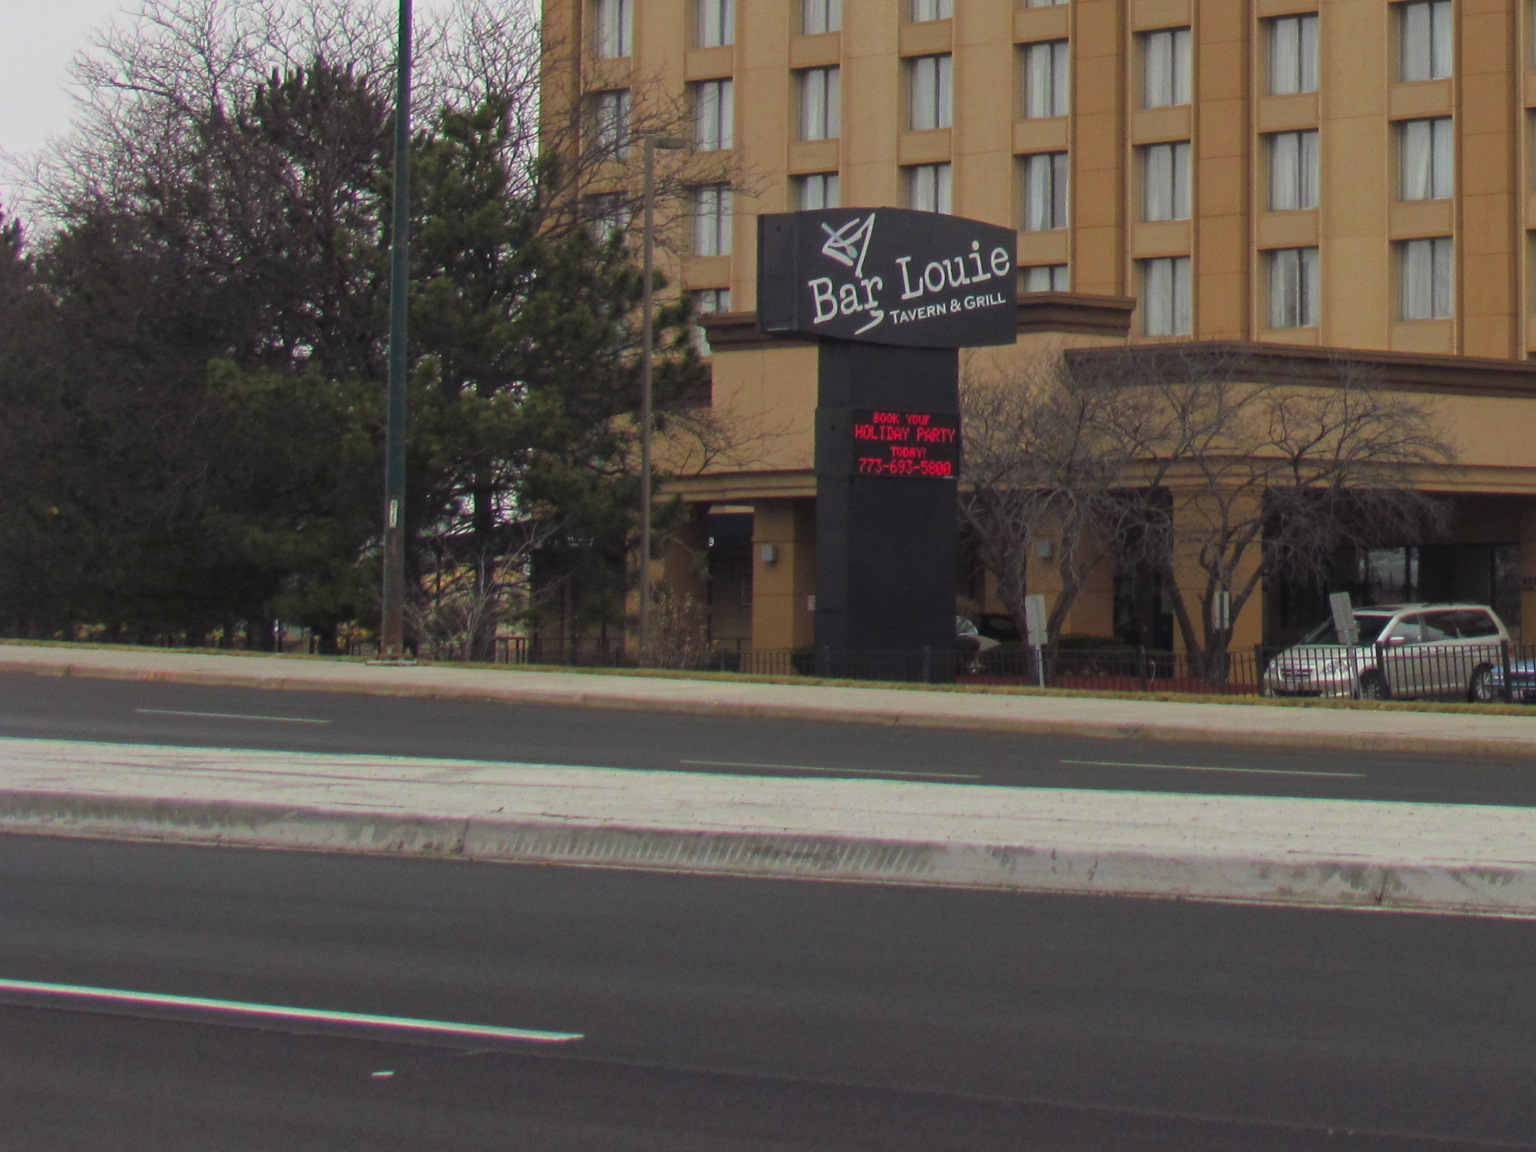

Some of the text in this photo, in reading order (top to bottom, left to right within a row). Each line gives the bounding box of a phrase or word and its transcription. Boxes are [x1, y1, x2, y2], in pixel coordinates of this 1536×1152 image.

[808, 239, 1011, 324] Bar Louie
[889, 292, 1006, 325] TAVERN & GRILL
[873, 412, 930, 425] BOOK YOUR
[854, 424, 956, 442] HOLIDAY PARTY
[890, 445, 927, 458] TODAY!
[858, 458, 952, 475] 773-693-5800
